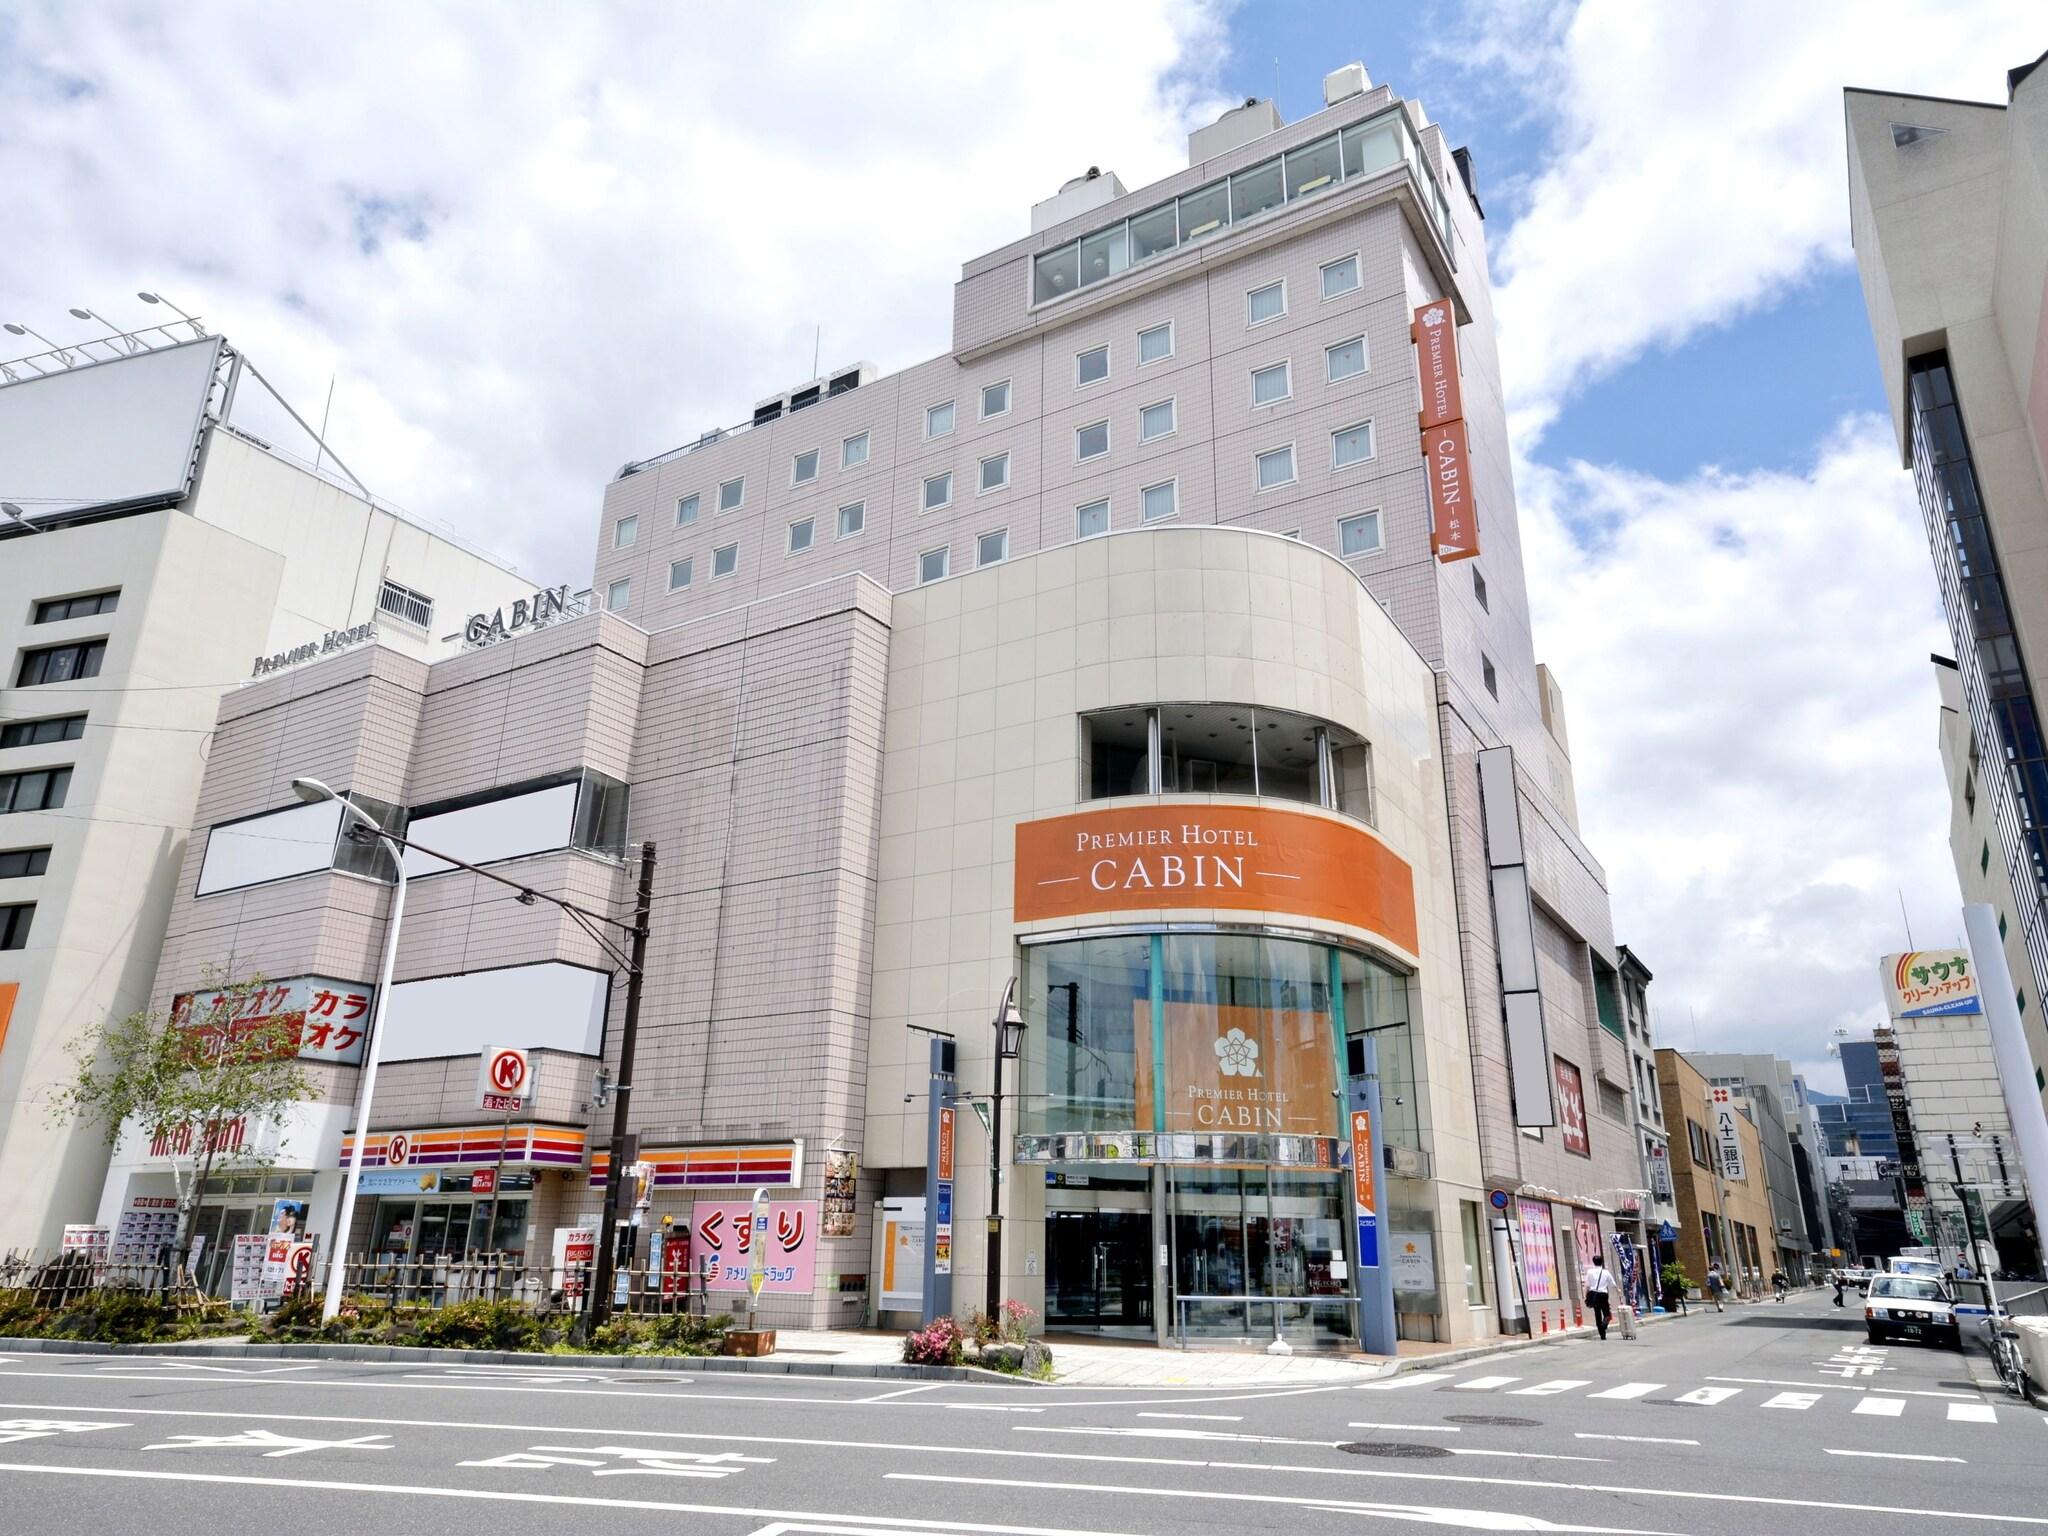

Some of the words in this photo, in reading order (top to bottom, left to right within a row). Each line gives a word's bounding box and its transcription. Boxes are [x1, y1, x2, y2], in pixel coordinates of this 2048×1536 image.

[1430, 329, 1443, 378] PREMIER
[1435, 378, 1448, 418] HOTEL
[1438, 440, 1460, 505] CABIN
[465, 584, 570, 646] CABIN
[252, 641, 318, 677] PREMIER
[321, 620, 377, 653] HOTEL
[1076, 829, 1172, 852] PREMIER
[1180, 824, 1258, 847] HOTEL
[1090, 855, 1245, 892] CABIN
[1911, 956, 1968, 986] サウナ
[309, 989, 368, 1019] カラ
[303, 1022, 365, 1051] オケ
[499, 1057, 517, 1085] K
[1188, 1085, 1243, 1100] PREMIER
[1247, 1088, 1289, 1103] HOTEL
[1198, 1105, 1282, 1127] CABIN
[392, 1140, 404, 1164] K
[1719, 1112, 1740, 1175] 八十二銀行
[1357, 1143, 1366, 1182] CABIN
